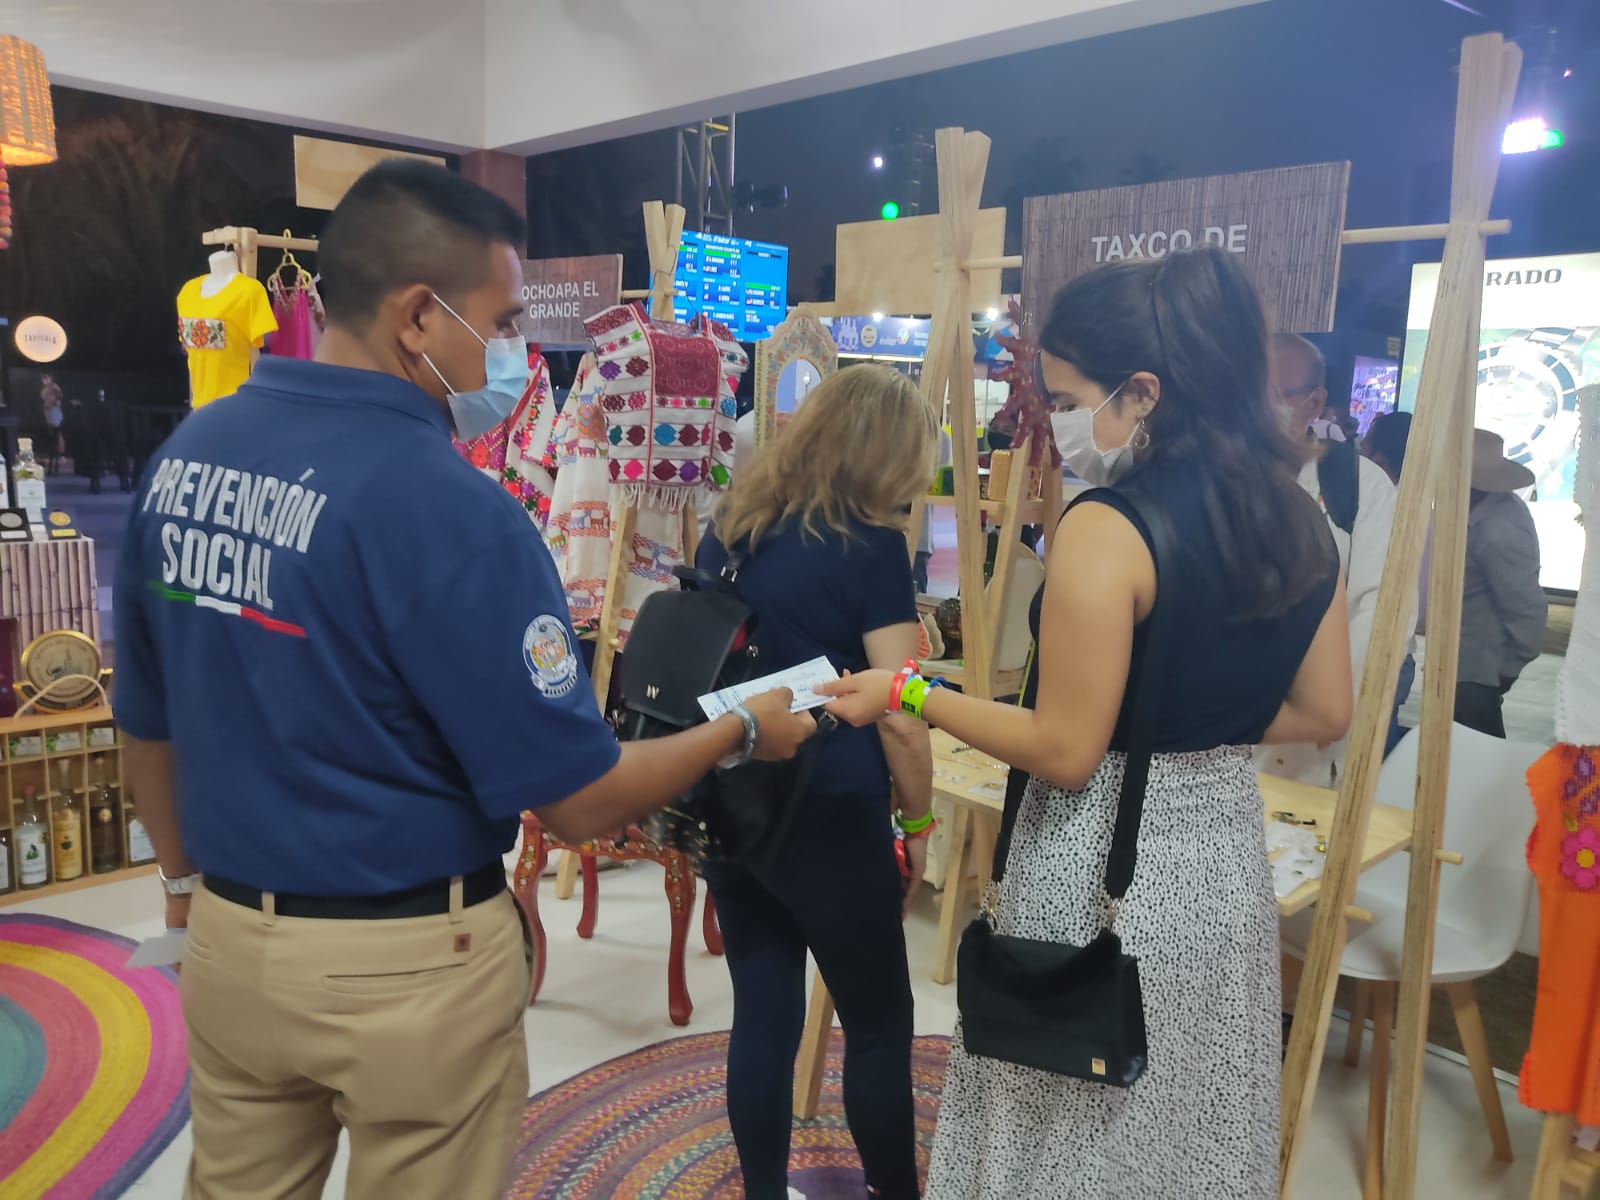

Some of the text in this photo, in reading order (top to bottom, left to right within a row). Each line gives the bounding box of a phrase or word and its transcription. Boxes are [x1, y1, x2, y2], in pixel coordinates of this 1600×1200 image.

[1092, 224, 1248, 263] TAXCO DE
[521, 280, 600, 300] OCHOAPA EL
[1485, 268, 1562, 286] RADO
[529, 301, 580, 319] GRANDE
[142, 457, 328, 554] PREVENCIÓN
[160, 521, 275, 611] SOCIAL
